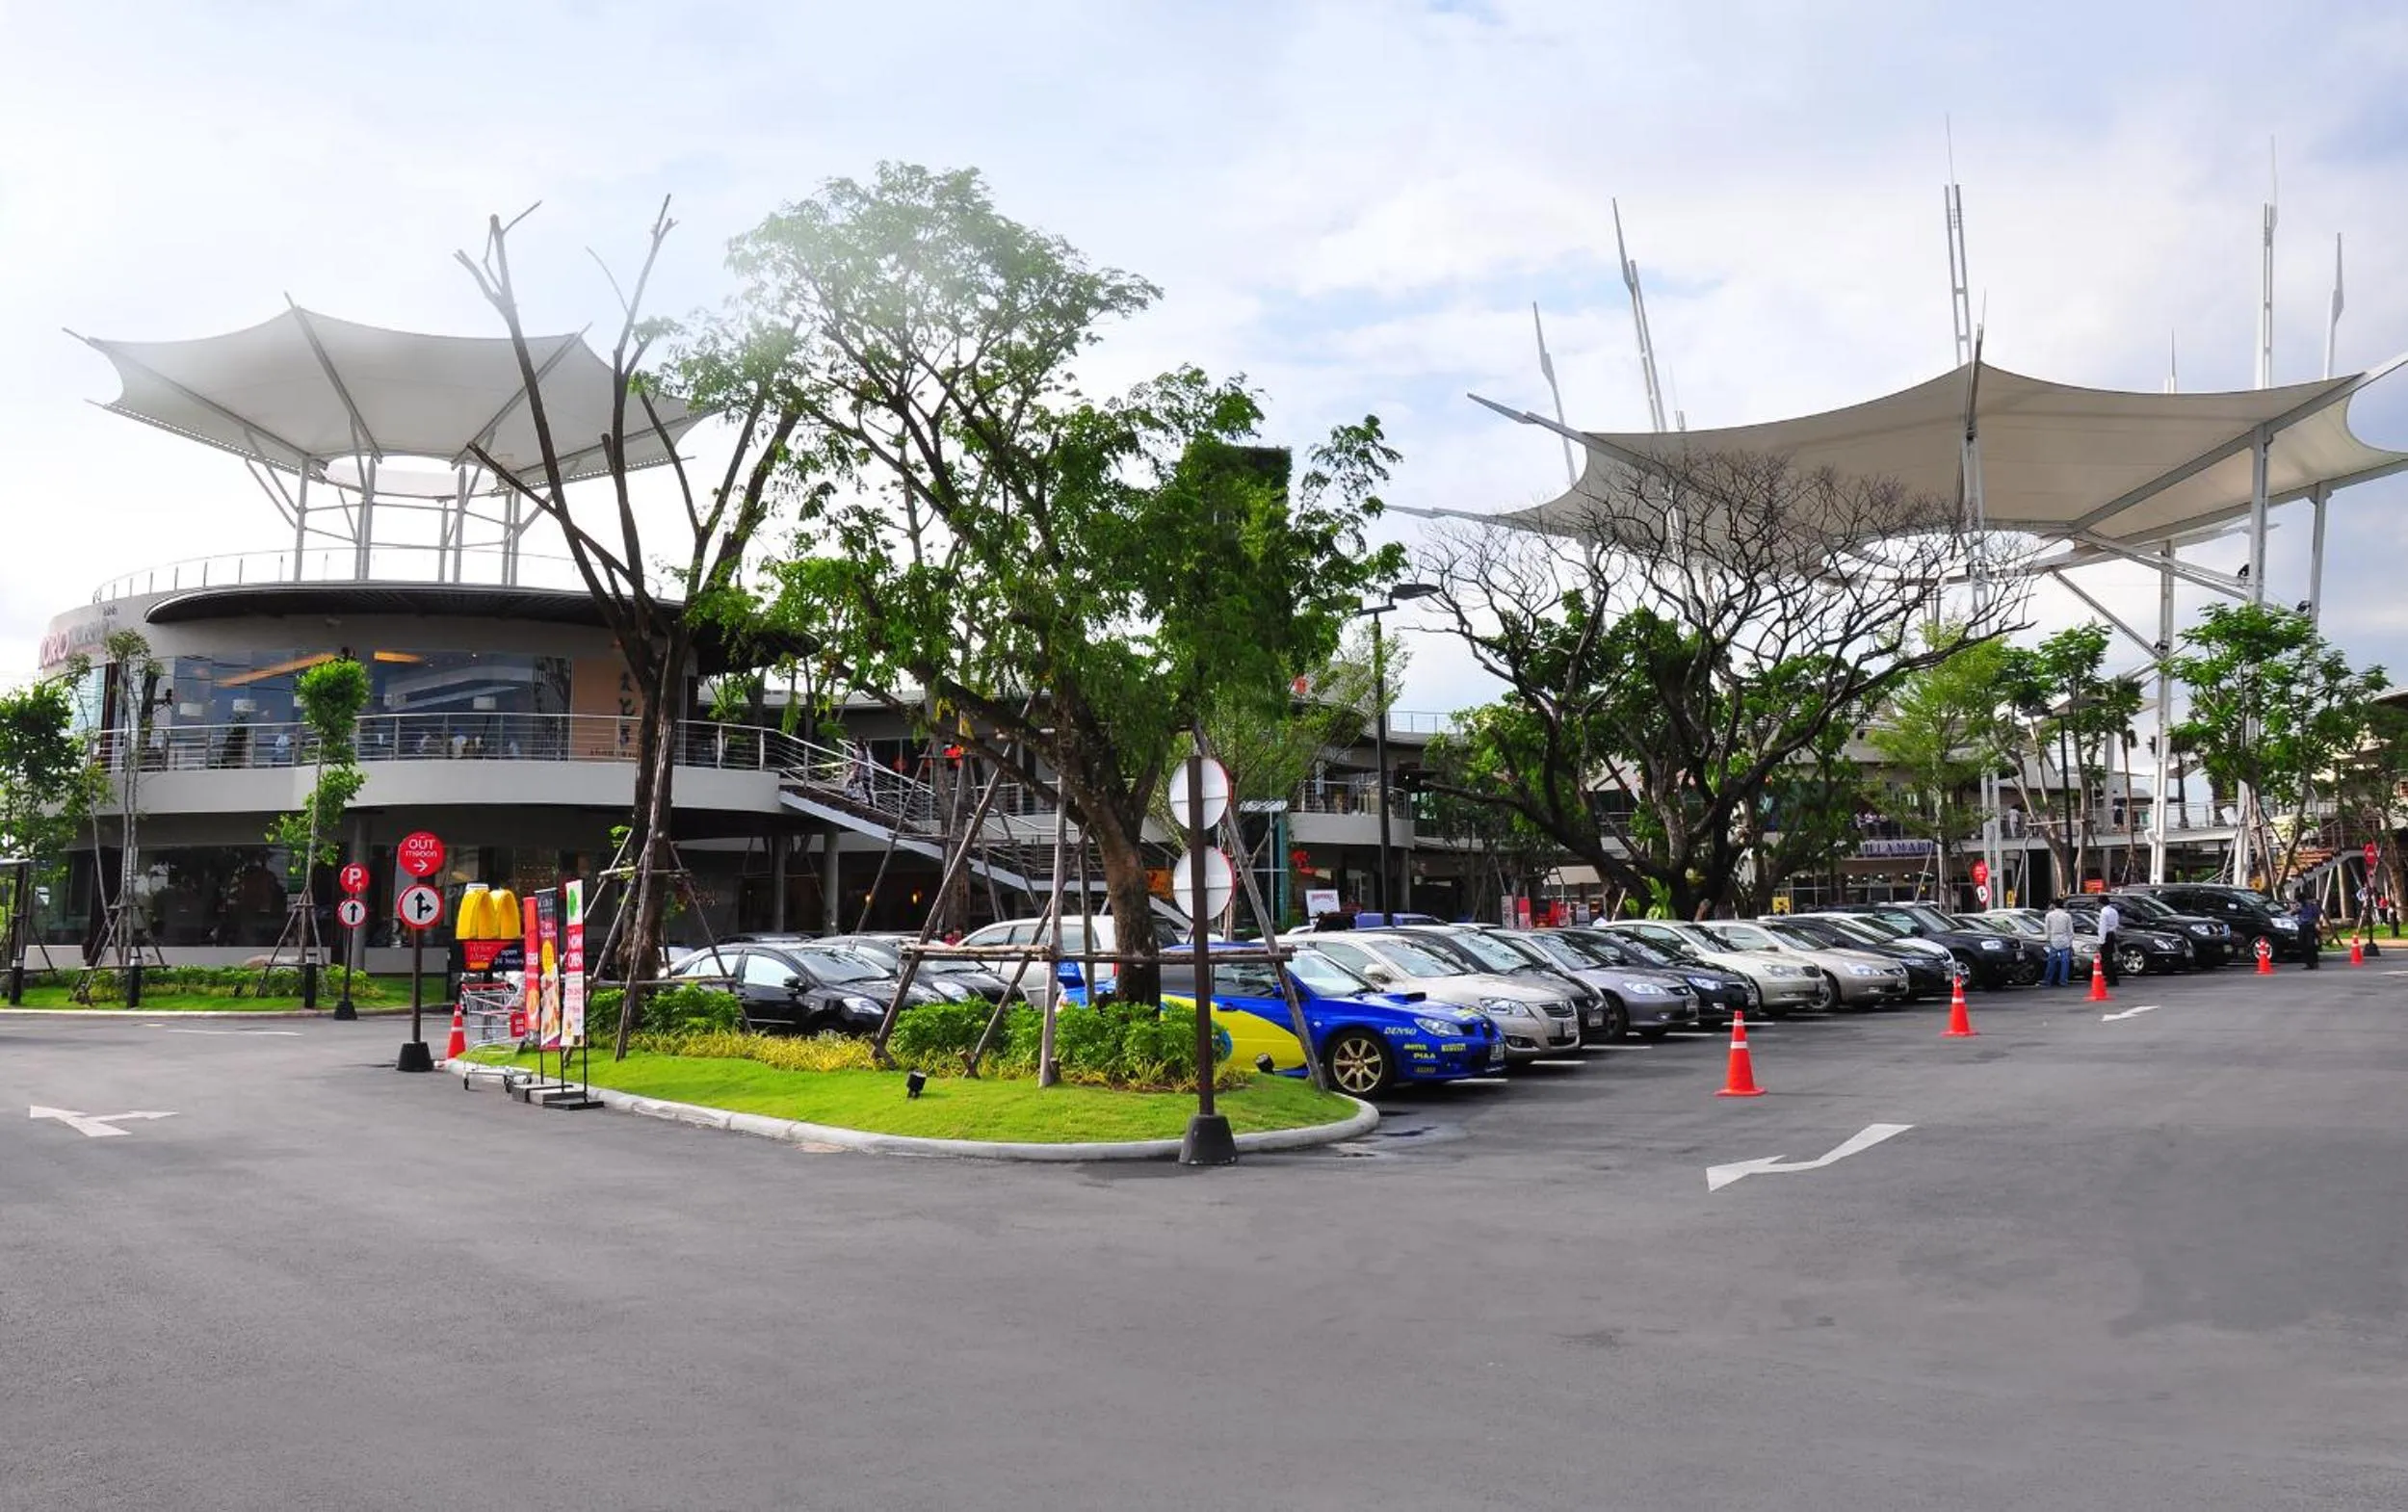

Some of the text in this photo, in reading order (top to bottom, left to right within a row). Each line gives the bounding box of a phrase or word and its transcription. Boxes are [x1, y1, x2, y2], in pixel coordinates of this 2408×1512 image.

[408, 839, 435, 849] OUT
[348, 868, 362, 885] P
[1383, 1027, 1417, 1035] DENSO
